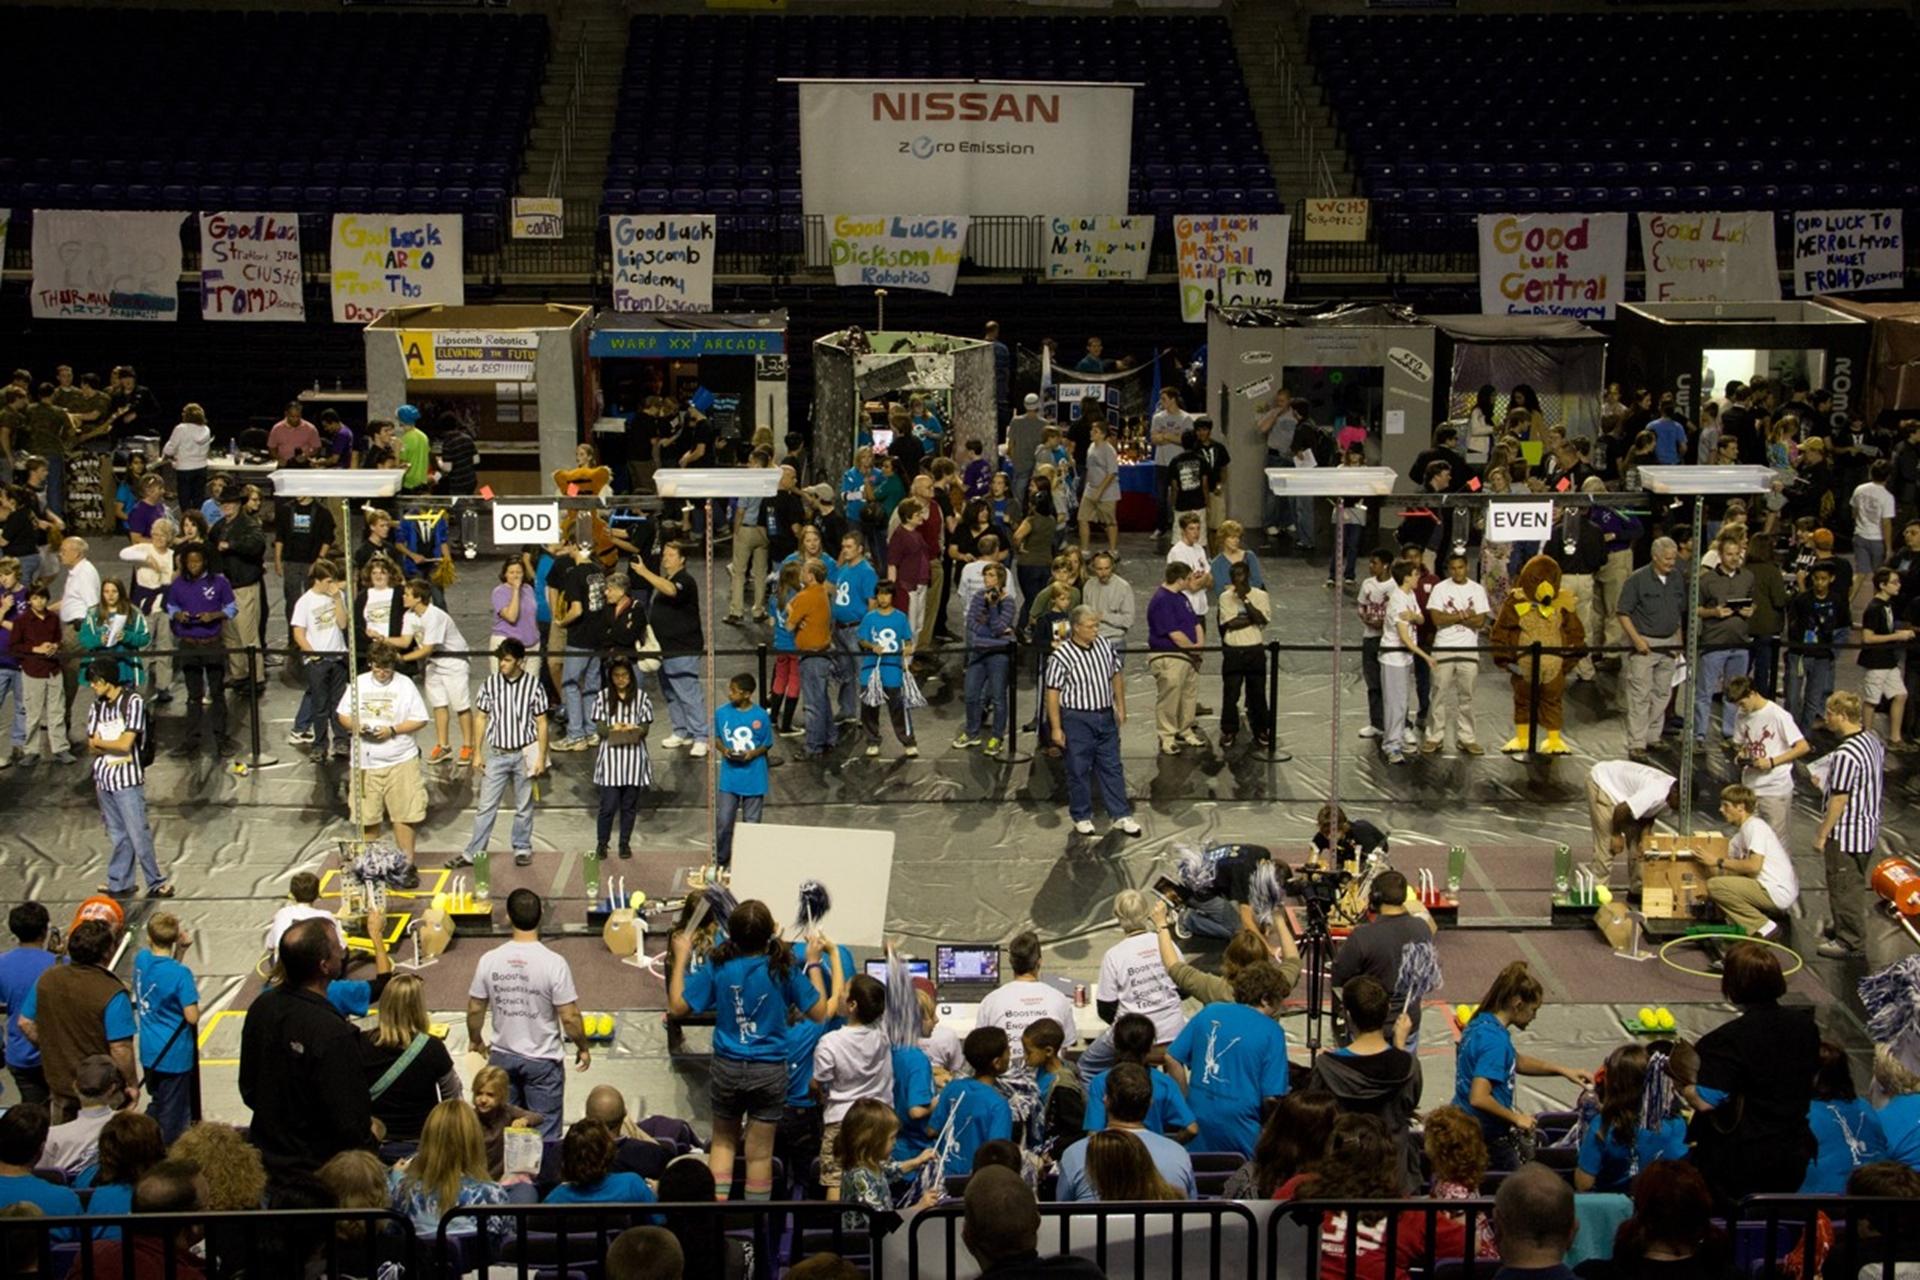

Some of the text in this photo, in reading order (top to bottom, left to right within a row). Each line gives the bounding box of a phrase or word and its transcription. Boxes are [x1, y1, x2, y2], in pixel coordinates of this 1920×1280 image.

[873, 92, 1059, 123] NISSAN
[959, 141, 1034, 154] Emission
[208, 216, 264, 240] Good
[616, 218, 713, 246] Good Luck
[835, 215, 885, 237] Good
[1177, 218, 1258, 239] Good Luck
[1650, 216, 1706, 241] Good
[1826, 215, 1866, 232] LUCK
[1871, 213, 1891, 230] TO
[390, 223, 442, 248] Luck
[1494, 217, 1589, 253] Good
[1860, 234, 1899, 249] HYDE
[617, 245, 700, 270] Lipscomb
[1180, 242, 1253, 265] Marshall
[1520, 251, 1569, 269] Luck
[616, 269, 685, 294] Academy
[862, 267, 930, 285] Robotics
[1500, 272, 1607, 303] Central
[615, 289, 652, 310] From
[437, 335, 528, 345] Lipscomb Robotics
[610, 337, 767, 351] WARP XX ARCADE
[437, 348, 484, 359] ELEVATING
[501, 513, 551, 531] ODD
[1494, 512, 1548, 527] EVEN
